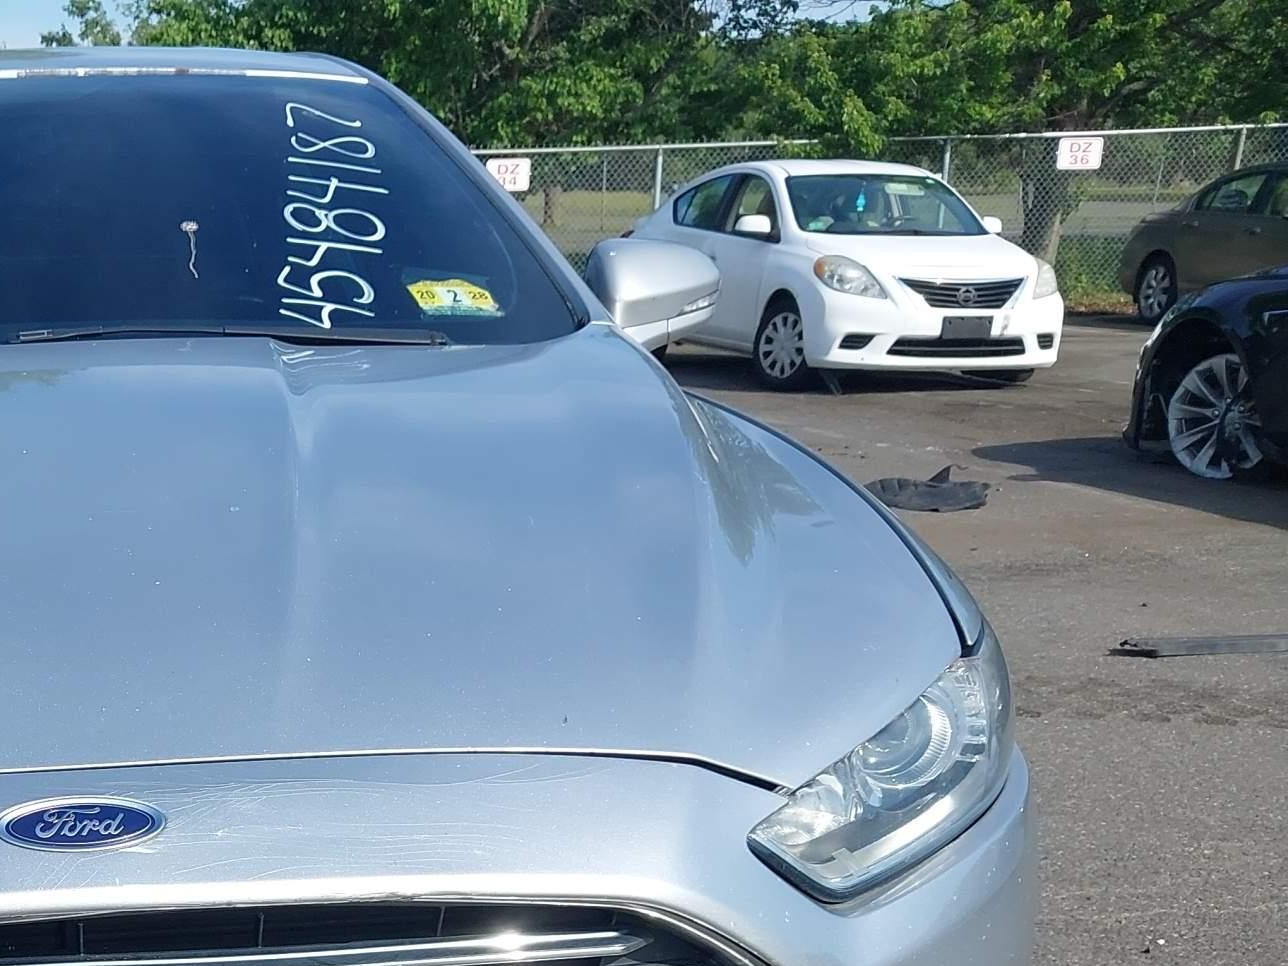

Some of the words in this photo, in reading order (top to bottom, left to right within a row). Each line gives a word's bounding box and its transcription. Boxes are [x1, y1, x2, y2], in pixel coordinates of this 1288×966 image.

[1069, 142, 1092, 153] DZ
[1069, 154, 1089, 165] 36
[497, 164, 520, 175] DZ
[277, 102, 390, 330] 45484187
[416, 290, 435, 299] 20
[446, 289, 462, 303] 2
[468, 290, 489, 300] 28
[34, 806, 125, 839] Ford
